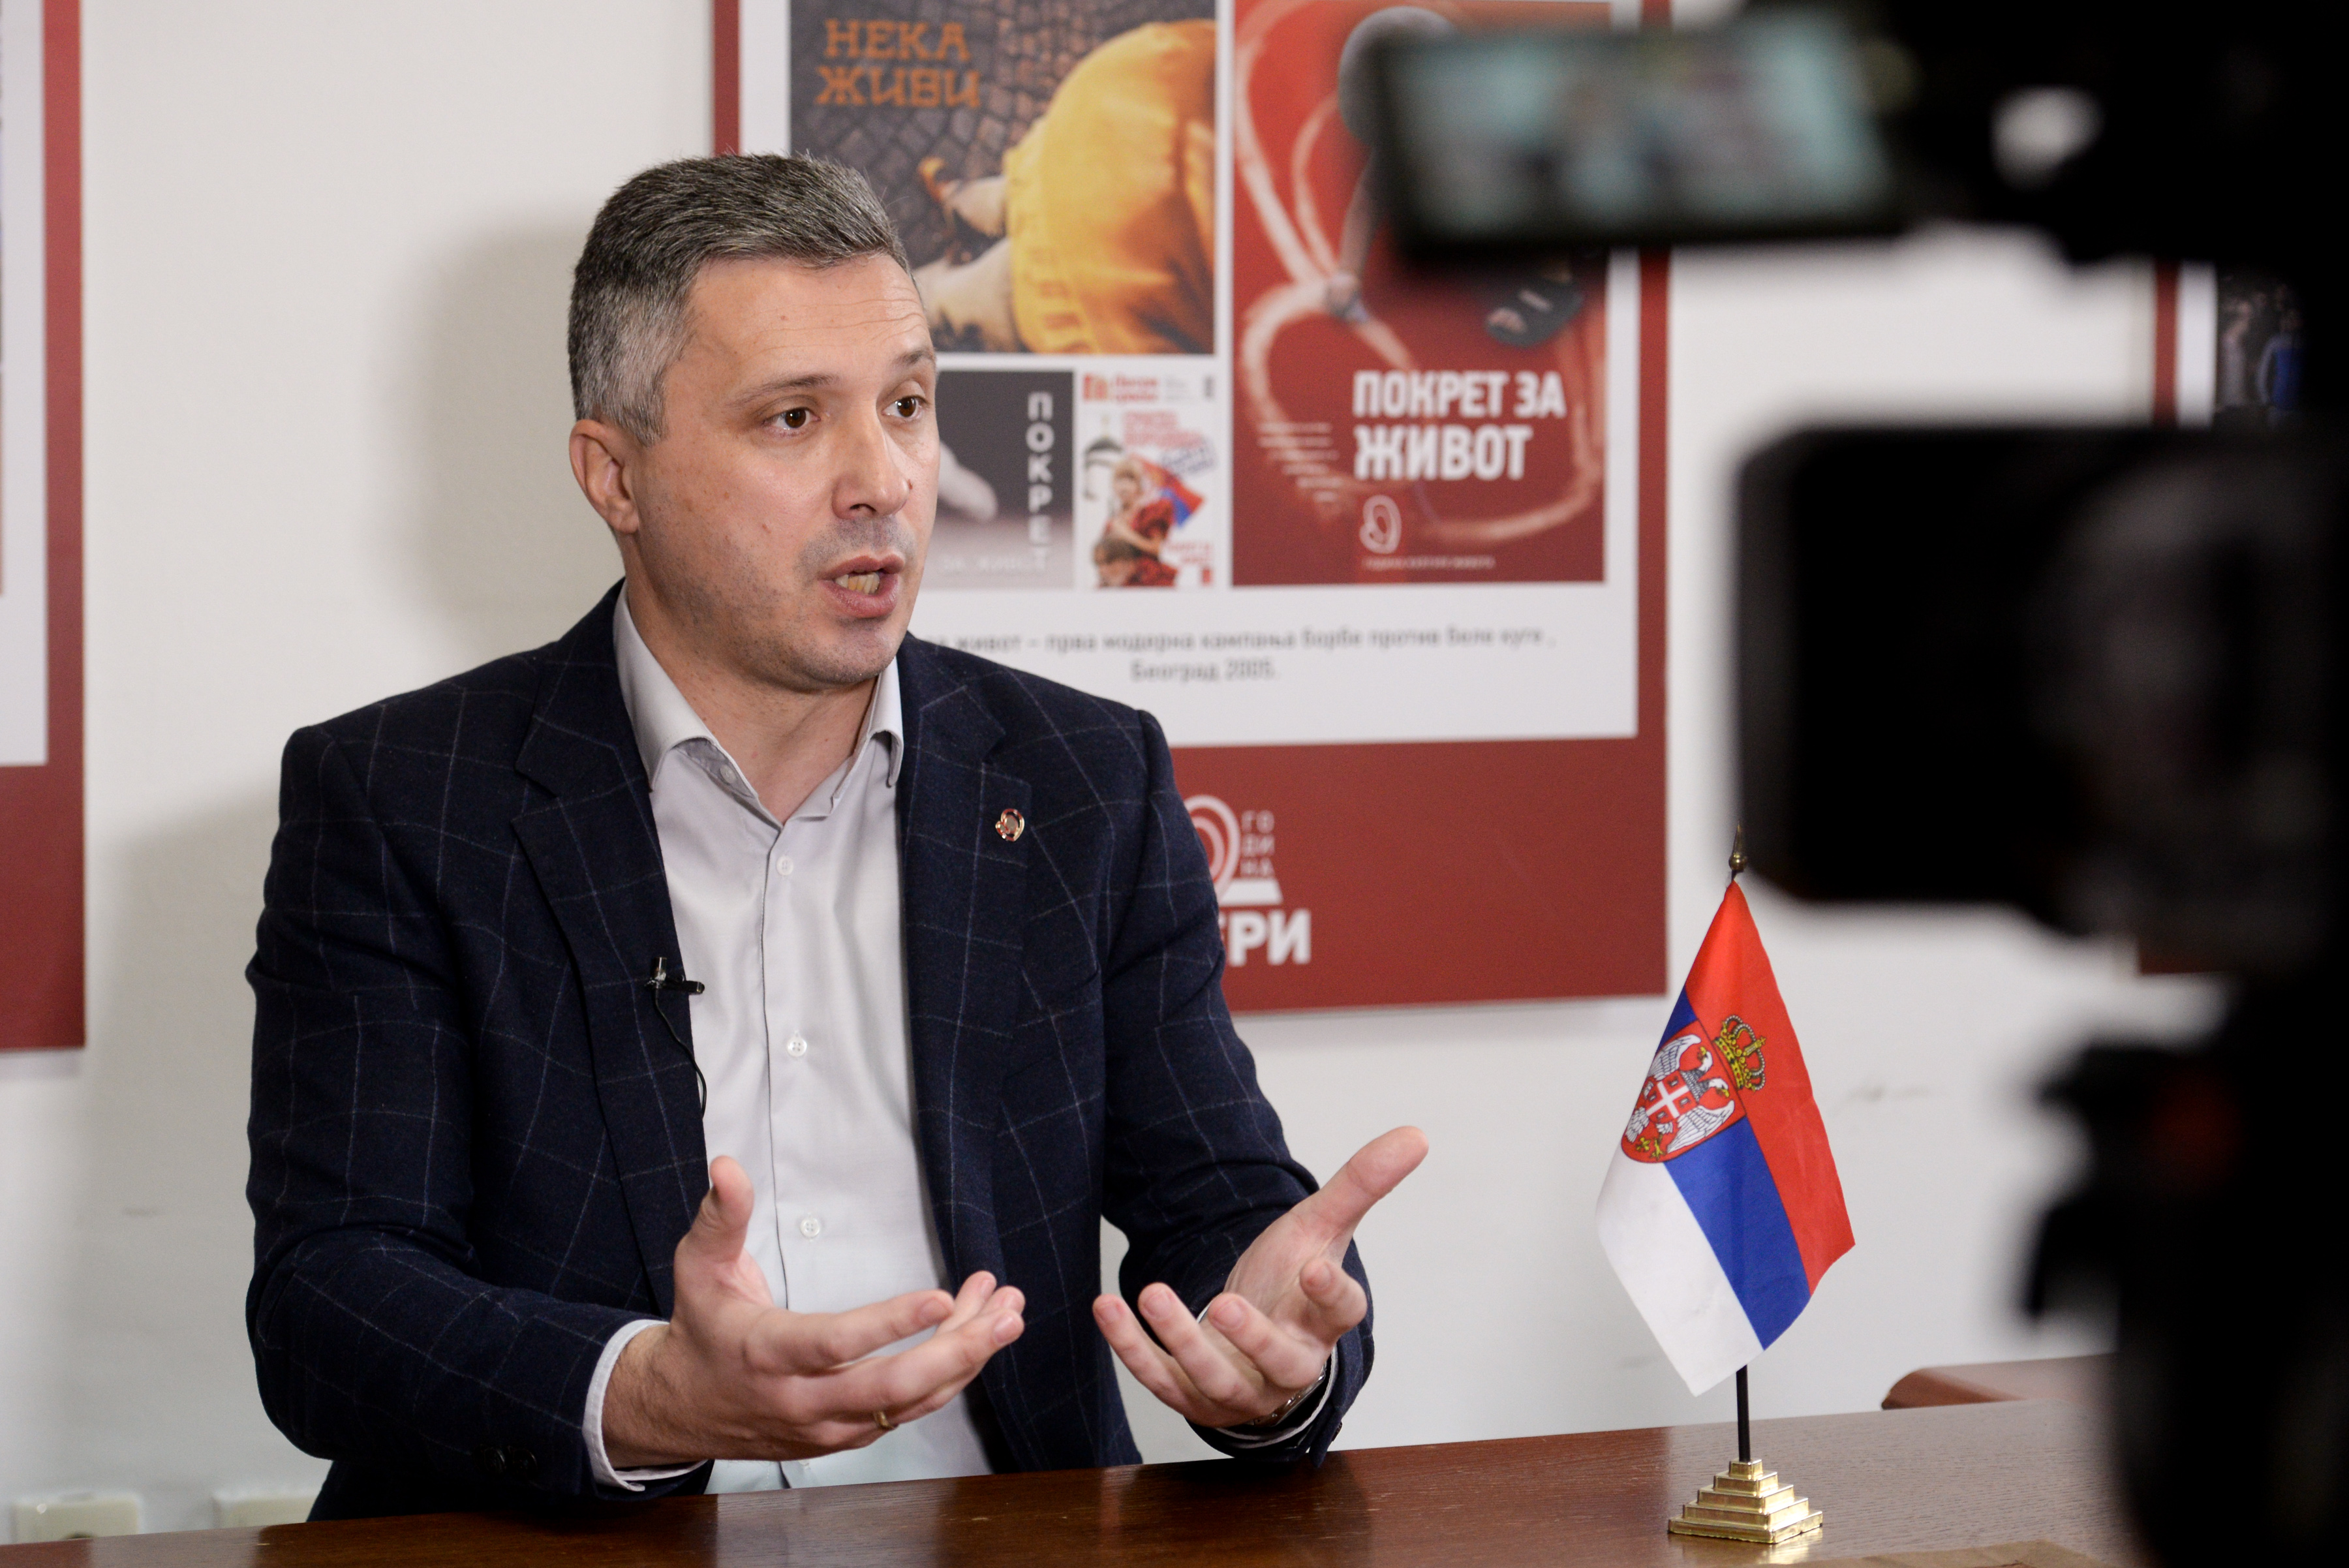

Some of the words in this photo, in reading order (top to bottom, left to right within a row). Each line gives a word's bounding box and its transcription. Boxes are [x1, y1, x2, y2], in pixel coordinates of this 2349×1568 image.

[823, 19, 971, 62] НЕКА
[815, 67, 980, 108] ЖИВИ
[1352, 370, 1510, 418] ПОКРЕТ
[1513, 370, 1566, 418] ЗА
[1353, 425, 1533, 480] ЖИВОТ
[1130, 658, 1219, 683] Београд
[1217, 908, 1312, 967] РИ
